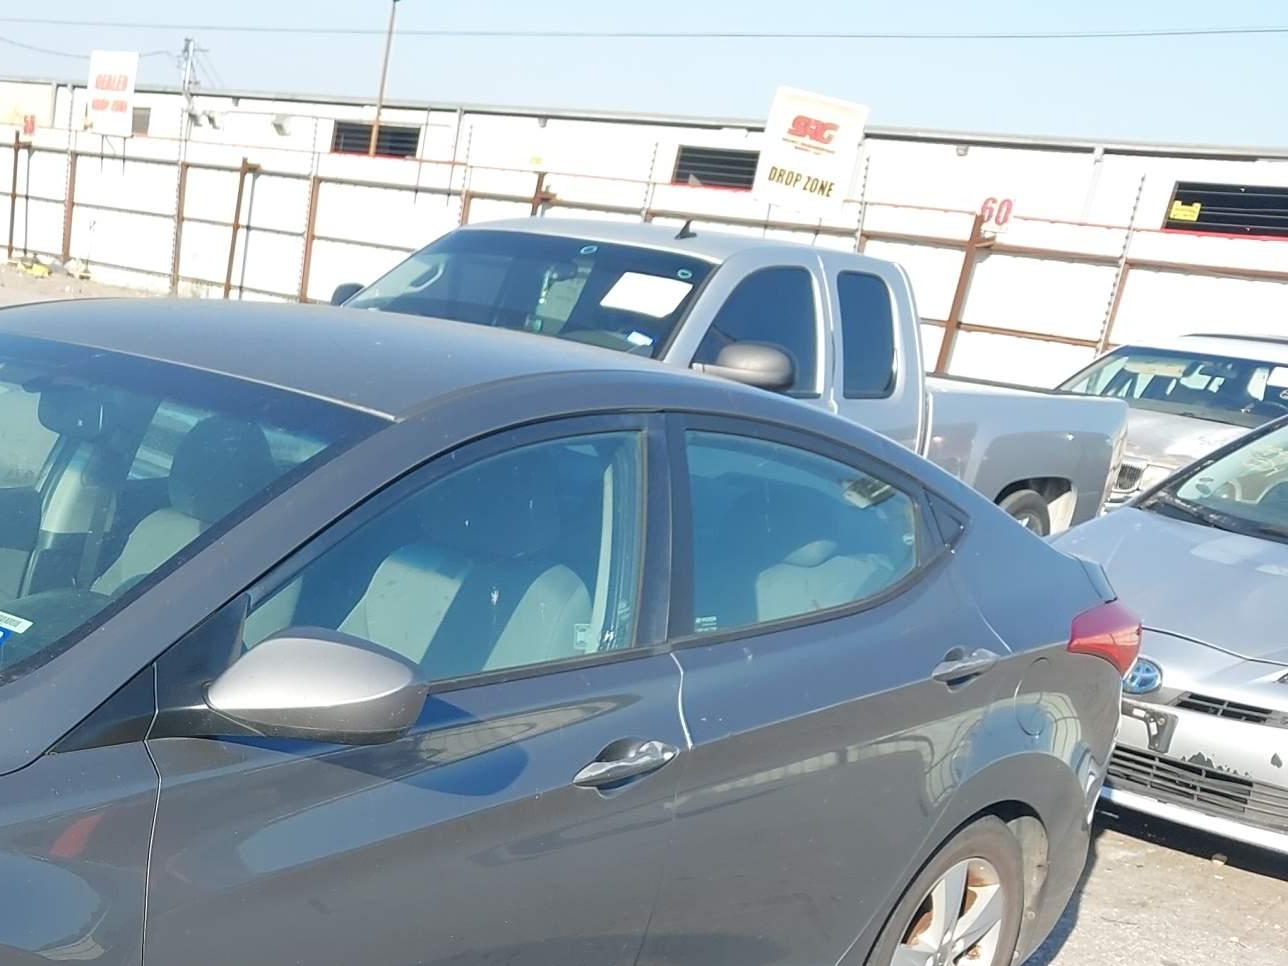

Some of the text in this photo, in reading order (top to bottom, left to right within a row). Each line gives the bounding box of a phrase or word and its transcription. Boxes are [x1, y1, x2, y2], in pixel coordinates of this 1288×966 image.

[768, 166, 836, 198] DROP ZONE
[981, 197, 1012, 225] 60
